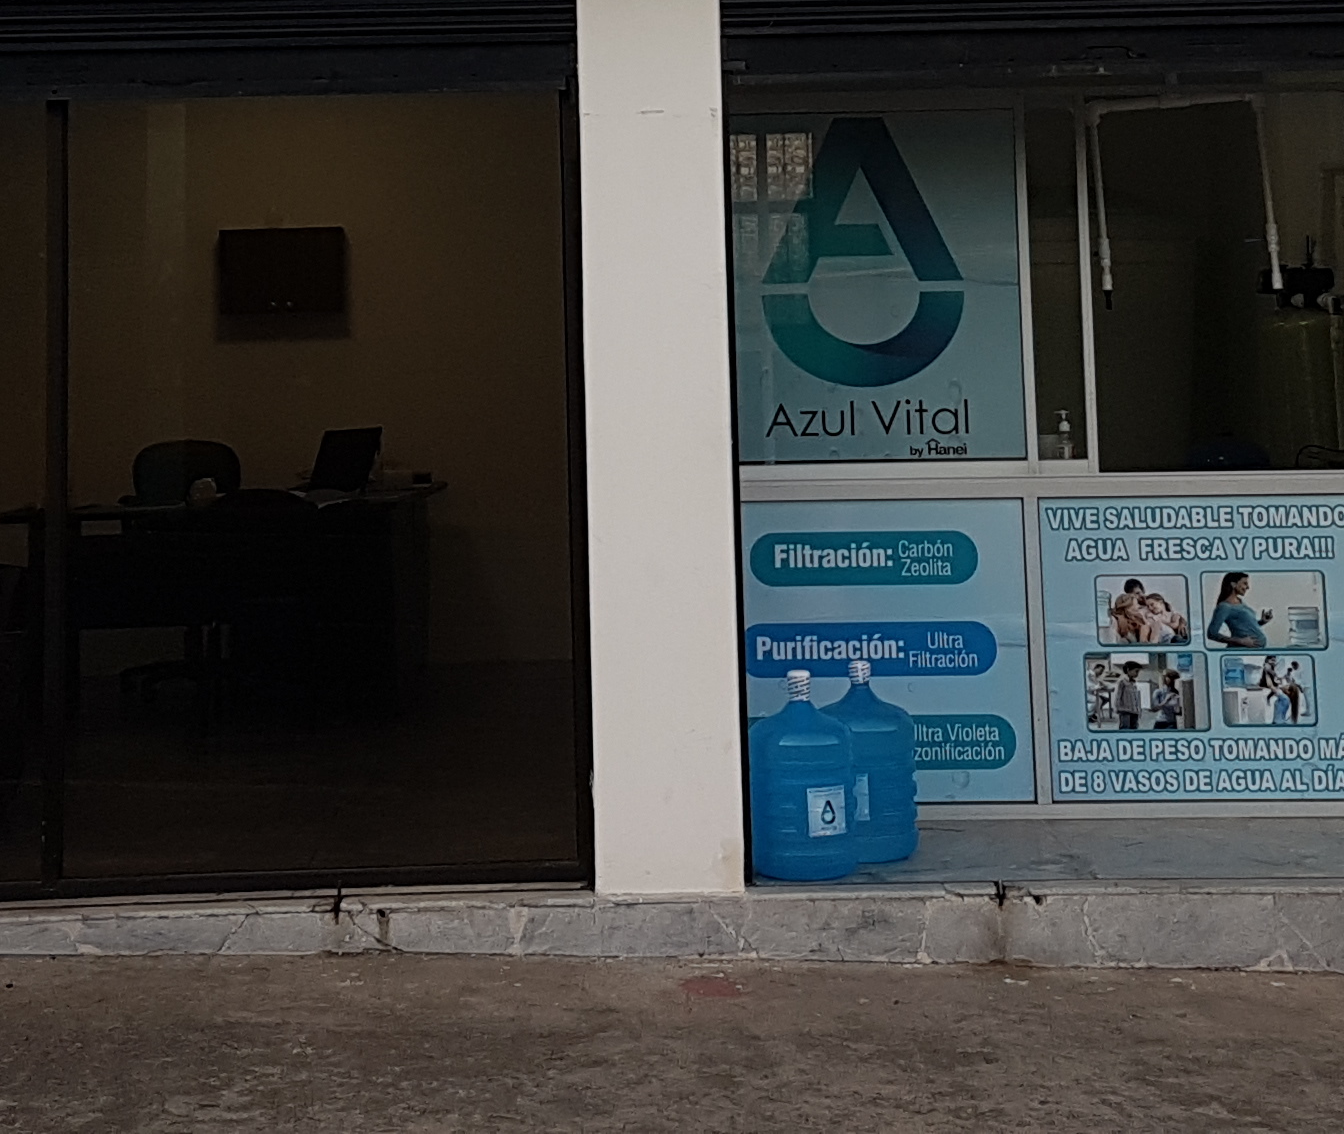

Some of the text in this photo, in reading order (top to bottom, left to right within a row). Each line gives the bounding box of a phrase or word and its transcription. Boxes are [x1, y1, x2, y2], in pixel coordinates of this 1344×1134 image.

[766, 399, 970, 438] Azul Vital
[909, 439, 967, 458] by Hanei
[1045, 506, 1100, 530] VIVE
[1103, 505, 1235, 530] SALUDABLE
[774, 539, 953, 569] Filtración: Carbón
[1065, 535, 1335, 562] AGUA FRESCA Y PURA!!!
[901, 558, 952, 577] Zeolita
[756, 631, 963, 661] Purificación: Ultra
[909, 649, 978, 669] Filtración
[946, 723, 1000, 741] Violeta
[912, 742, 1005, 761] zonificación
[1058, 738, 1114, 762] BAJA
[1117, 738, 1145, 761] DE
[1149, 738, 1206, 762] PESO
[1209, 737, 1315, 761] TOMANDO
[1058, 770, 1088, 793] DE
[1092, 770, 1106, 793] 8
[1109, 769, 1180, 793] VASOS
[1184, 769, 1213, 792] DE
[1216, 768, 1277, 792] AGUA
[1279, 768, 1309, 791] AL
